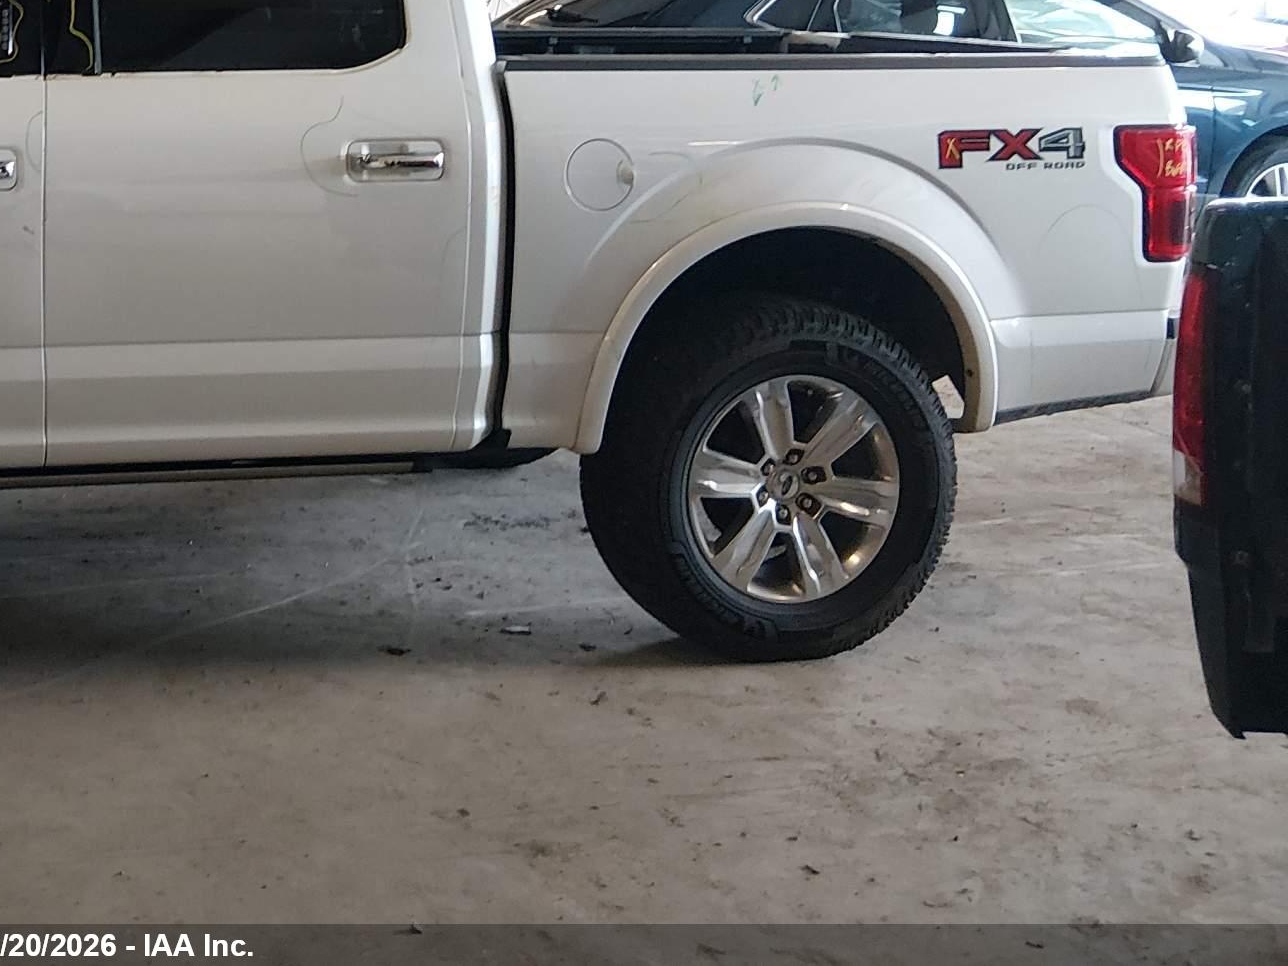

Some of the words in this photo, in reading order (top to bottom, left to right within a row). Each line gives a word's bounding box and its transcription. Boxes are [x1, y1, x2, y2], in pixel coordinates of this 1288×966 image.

[938, 127, 1085, 169] FX4
[1005, 162, 1039, 171] OFF
[1043, 160, 1086, 170] ROAD
